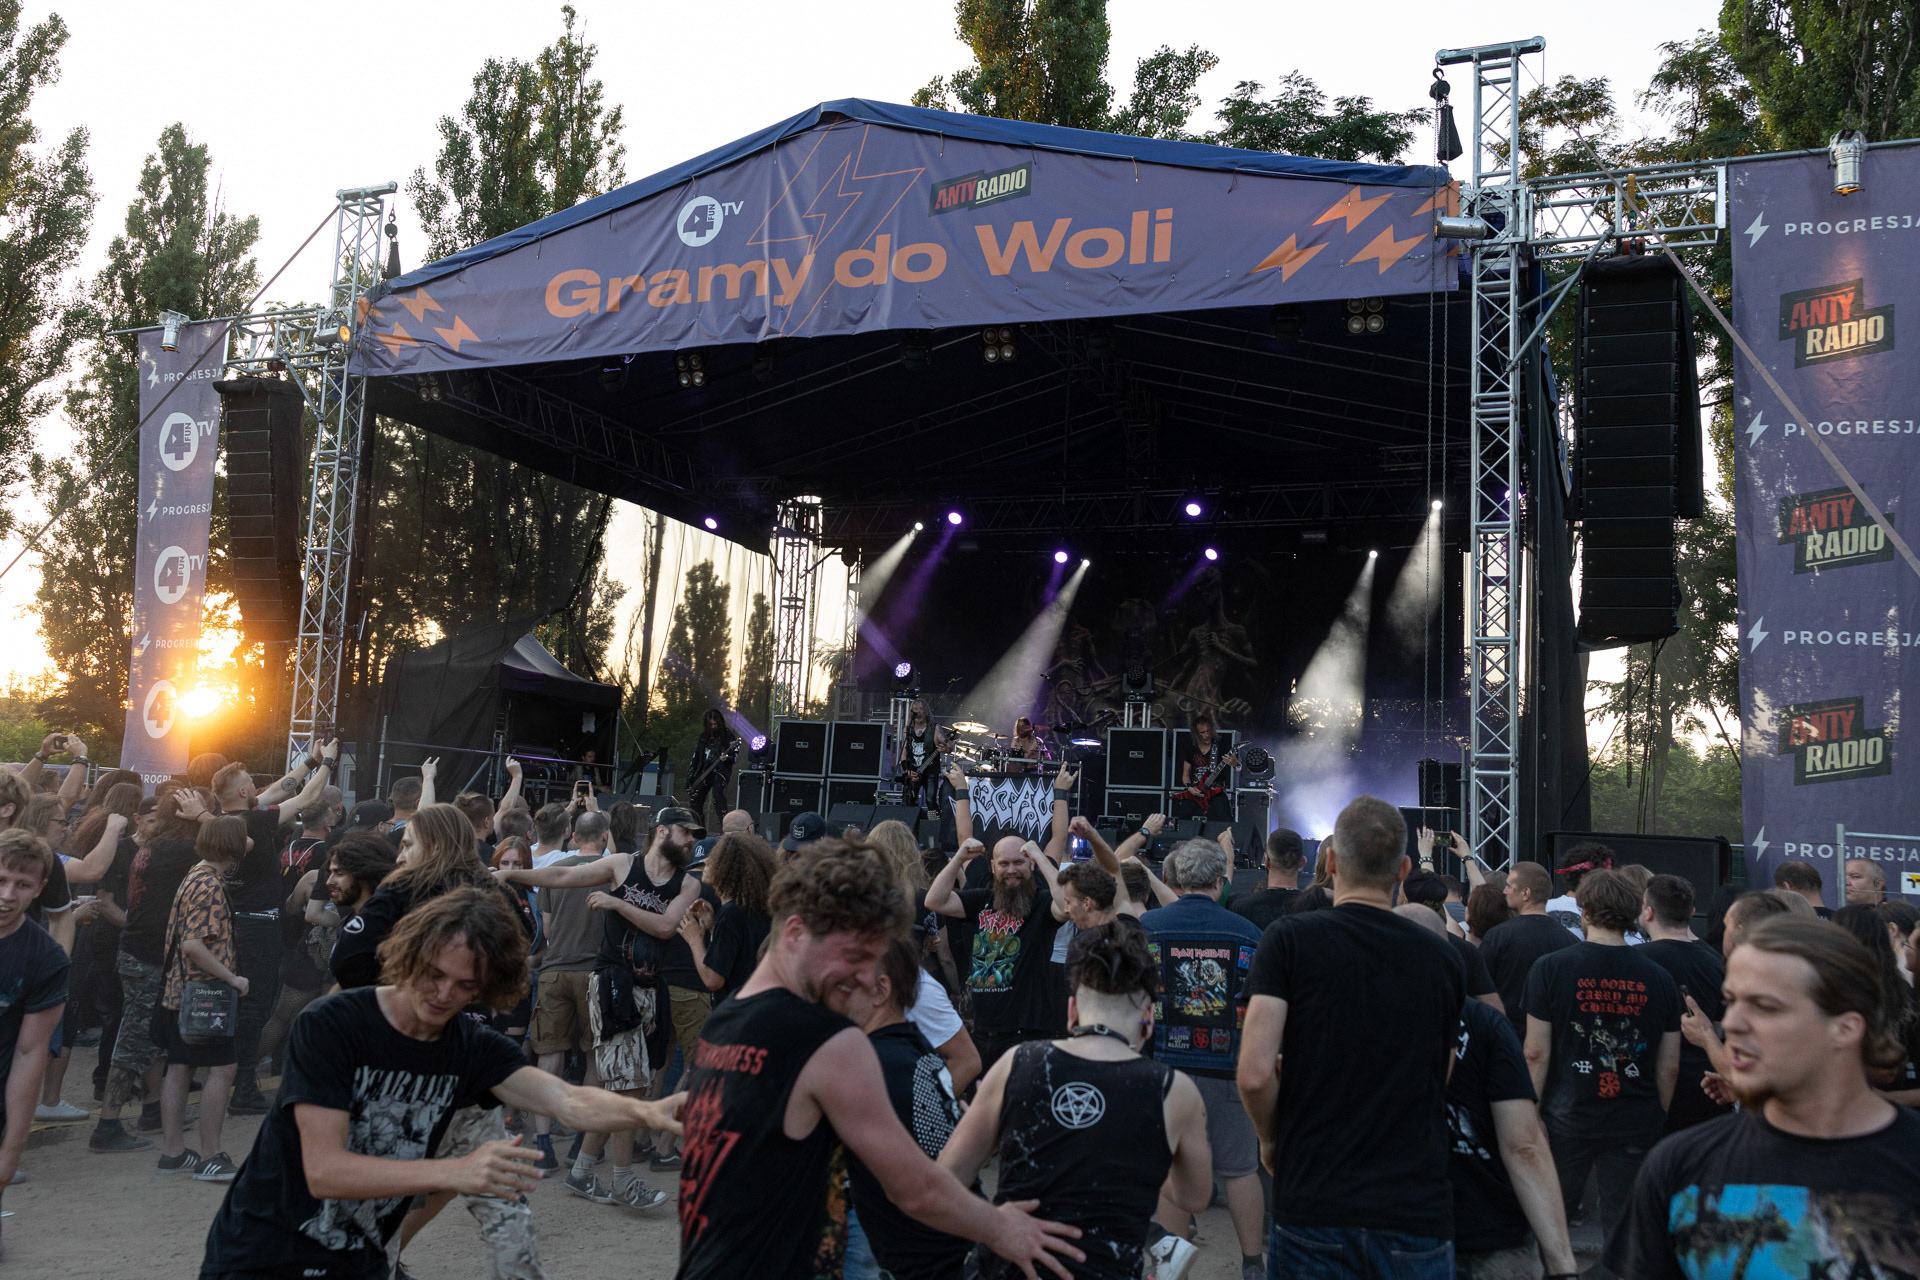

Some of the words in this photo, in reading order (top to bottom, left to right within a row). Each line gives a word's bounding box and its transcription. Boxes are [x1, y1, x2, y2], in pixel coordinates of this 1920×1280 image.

[708, 203, 716, 221] FUN
[722, 201, 744, 216] TV
[1785, 215, 1920, 236] PROGRESJ
[545, 252, 816, 319] Gramy
[833, 234, 946, 288] do
[974, 207, 1173, 276] Woli
[1789, 291, 1855, 331] ANTY
[1805, 315, 1885, 356] RADIO
[184, 422, 192, 442] FUN
[197, 420, 214, 437] TV
[1789, 497, 1855, 536] ANTY
[1805, 523, 1885, 562] RADIO
[190, 554, 205, 571] TV
[1789, 709, 1855, 746] ANTY
[1805, 736, 1884, 773] RADIO
[1170, 947, 1194, 959] IRON
[1195, 949, 1230, 960] MAIDEN
[1577, 978, 1597, 989] 666
[1575, 990, 1622, 1003] CARRY
[1625, 993, 1648, 1007] MY
